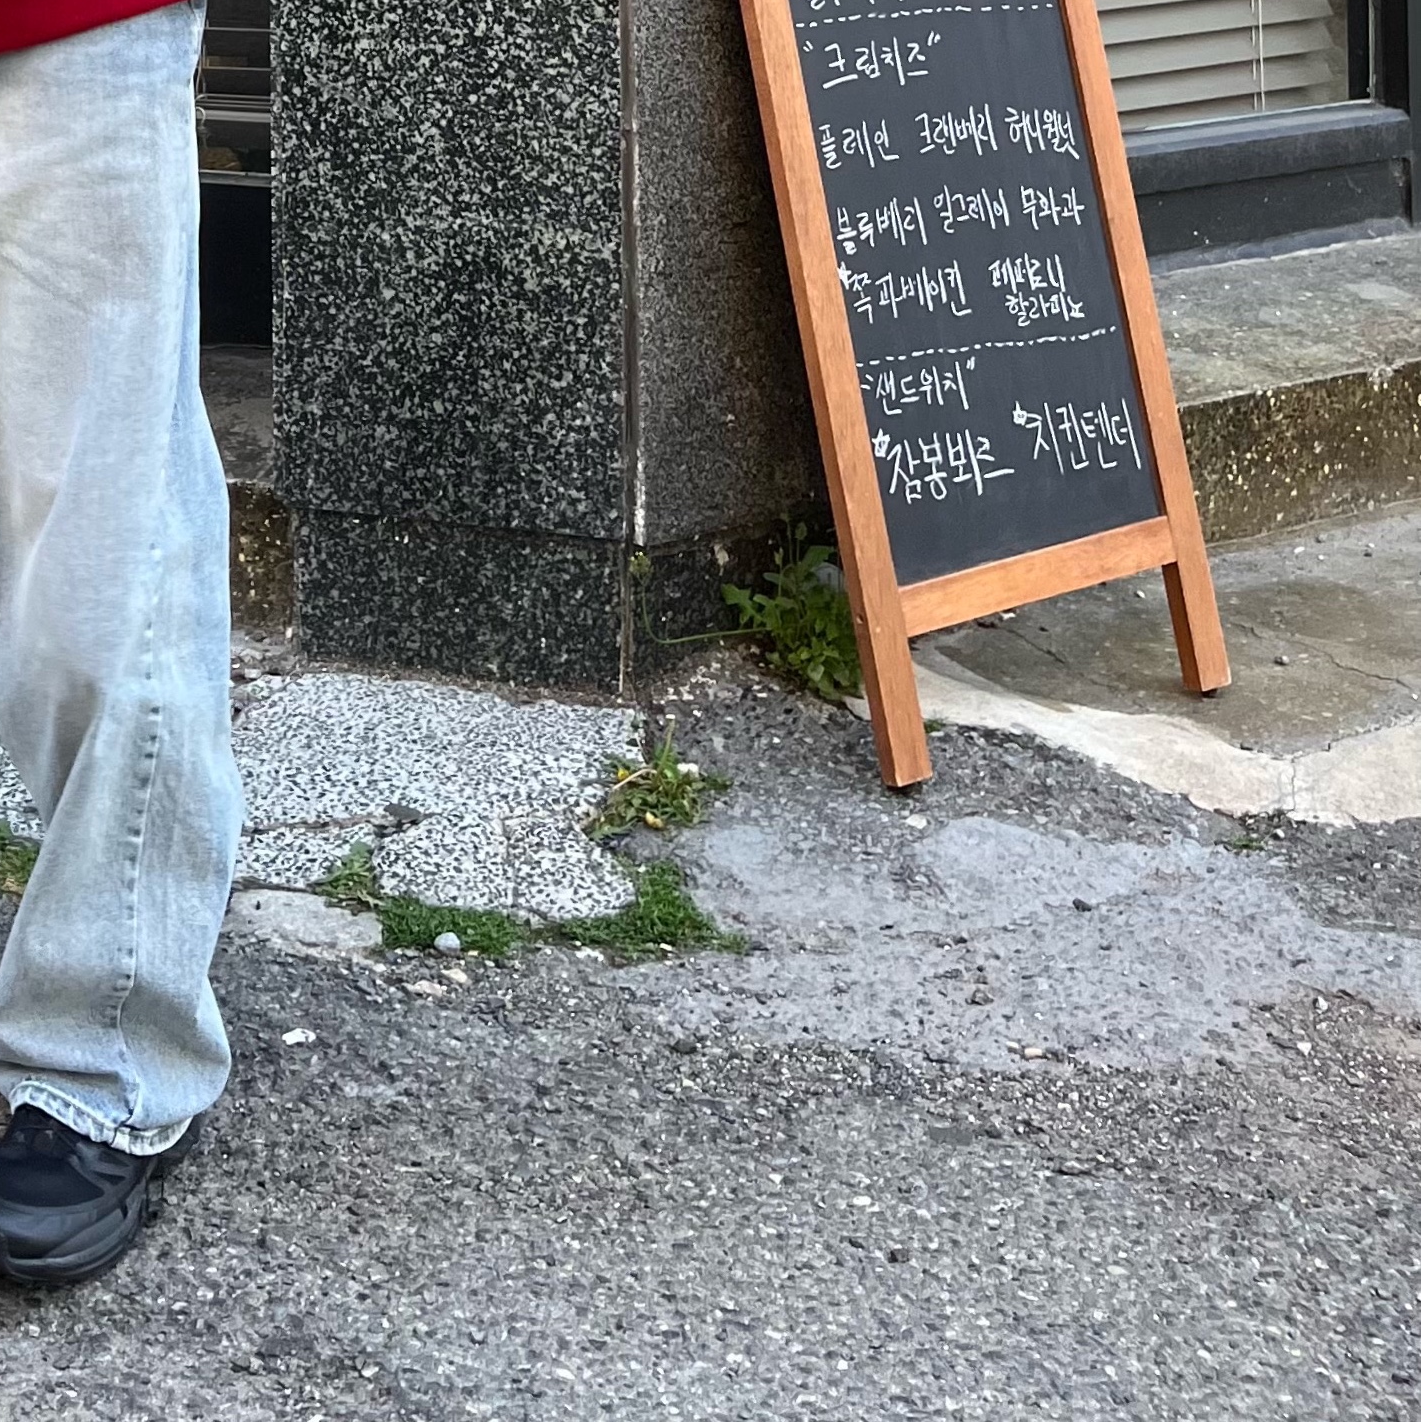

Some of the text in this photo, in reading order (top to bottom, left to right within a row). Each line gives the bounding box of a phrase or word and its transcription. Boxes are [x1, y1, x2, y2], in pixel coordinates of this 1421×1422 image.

[818, 119, 900, 170] 플레인
[1004, 106, 1080, 159] 허니월넛
[836, 196, 928, 255] 블루베리
[1021, 185, 1085, 230] 무화과
[988, 252, 1066, 294] 페퍼로니
[887, 428, 1015, 504] 잠봉뵈르
[1025, 398, 1141, 475] 치킨텐더
